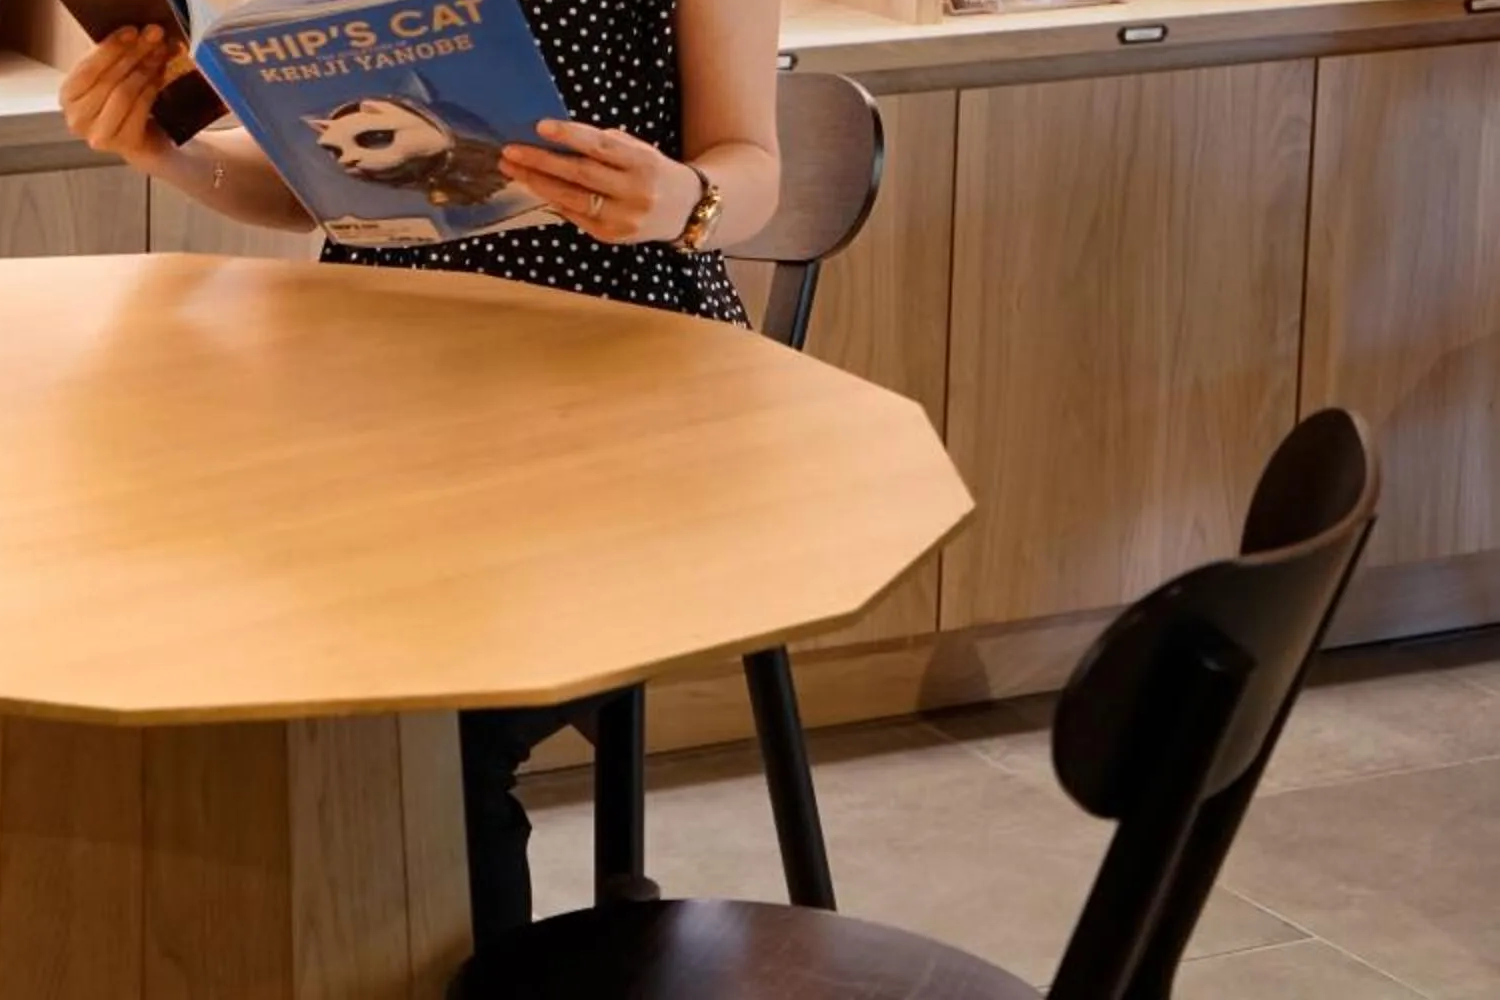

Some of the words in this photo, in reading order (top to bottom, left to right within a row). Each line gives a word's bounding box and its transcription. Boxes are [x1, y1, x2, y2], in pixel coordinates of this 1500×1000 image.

[220, 21, 377, 65] SHIP'S
[260, 59, 350, 84] KENJI
[355, 33, 475, 73] YANOBE
